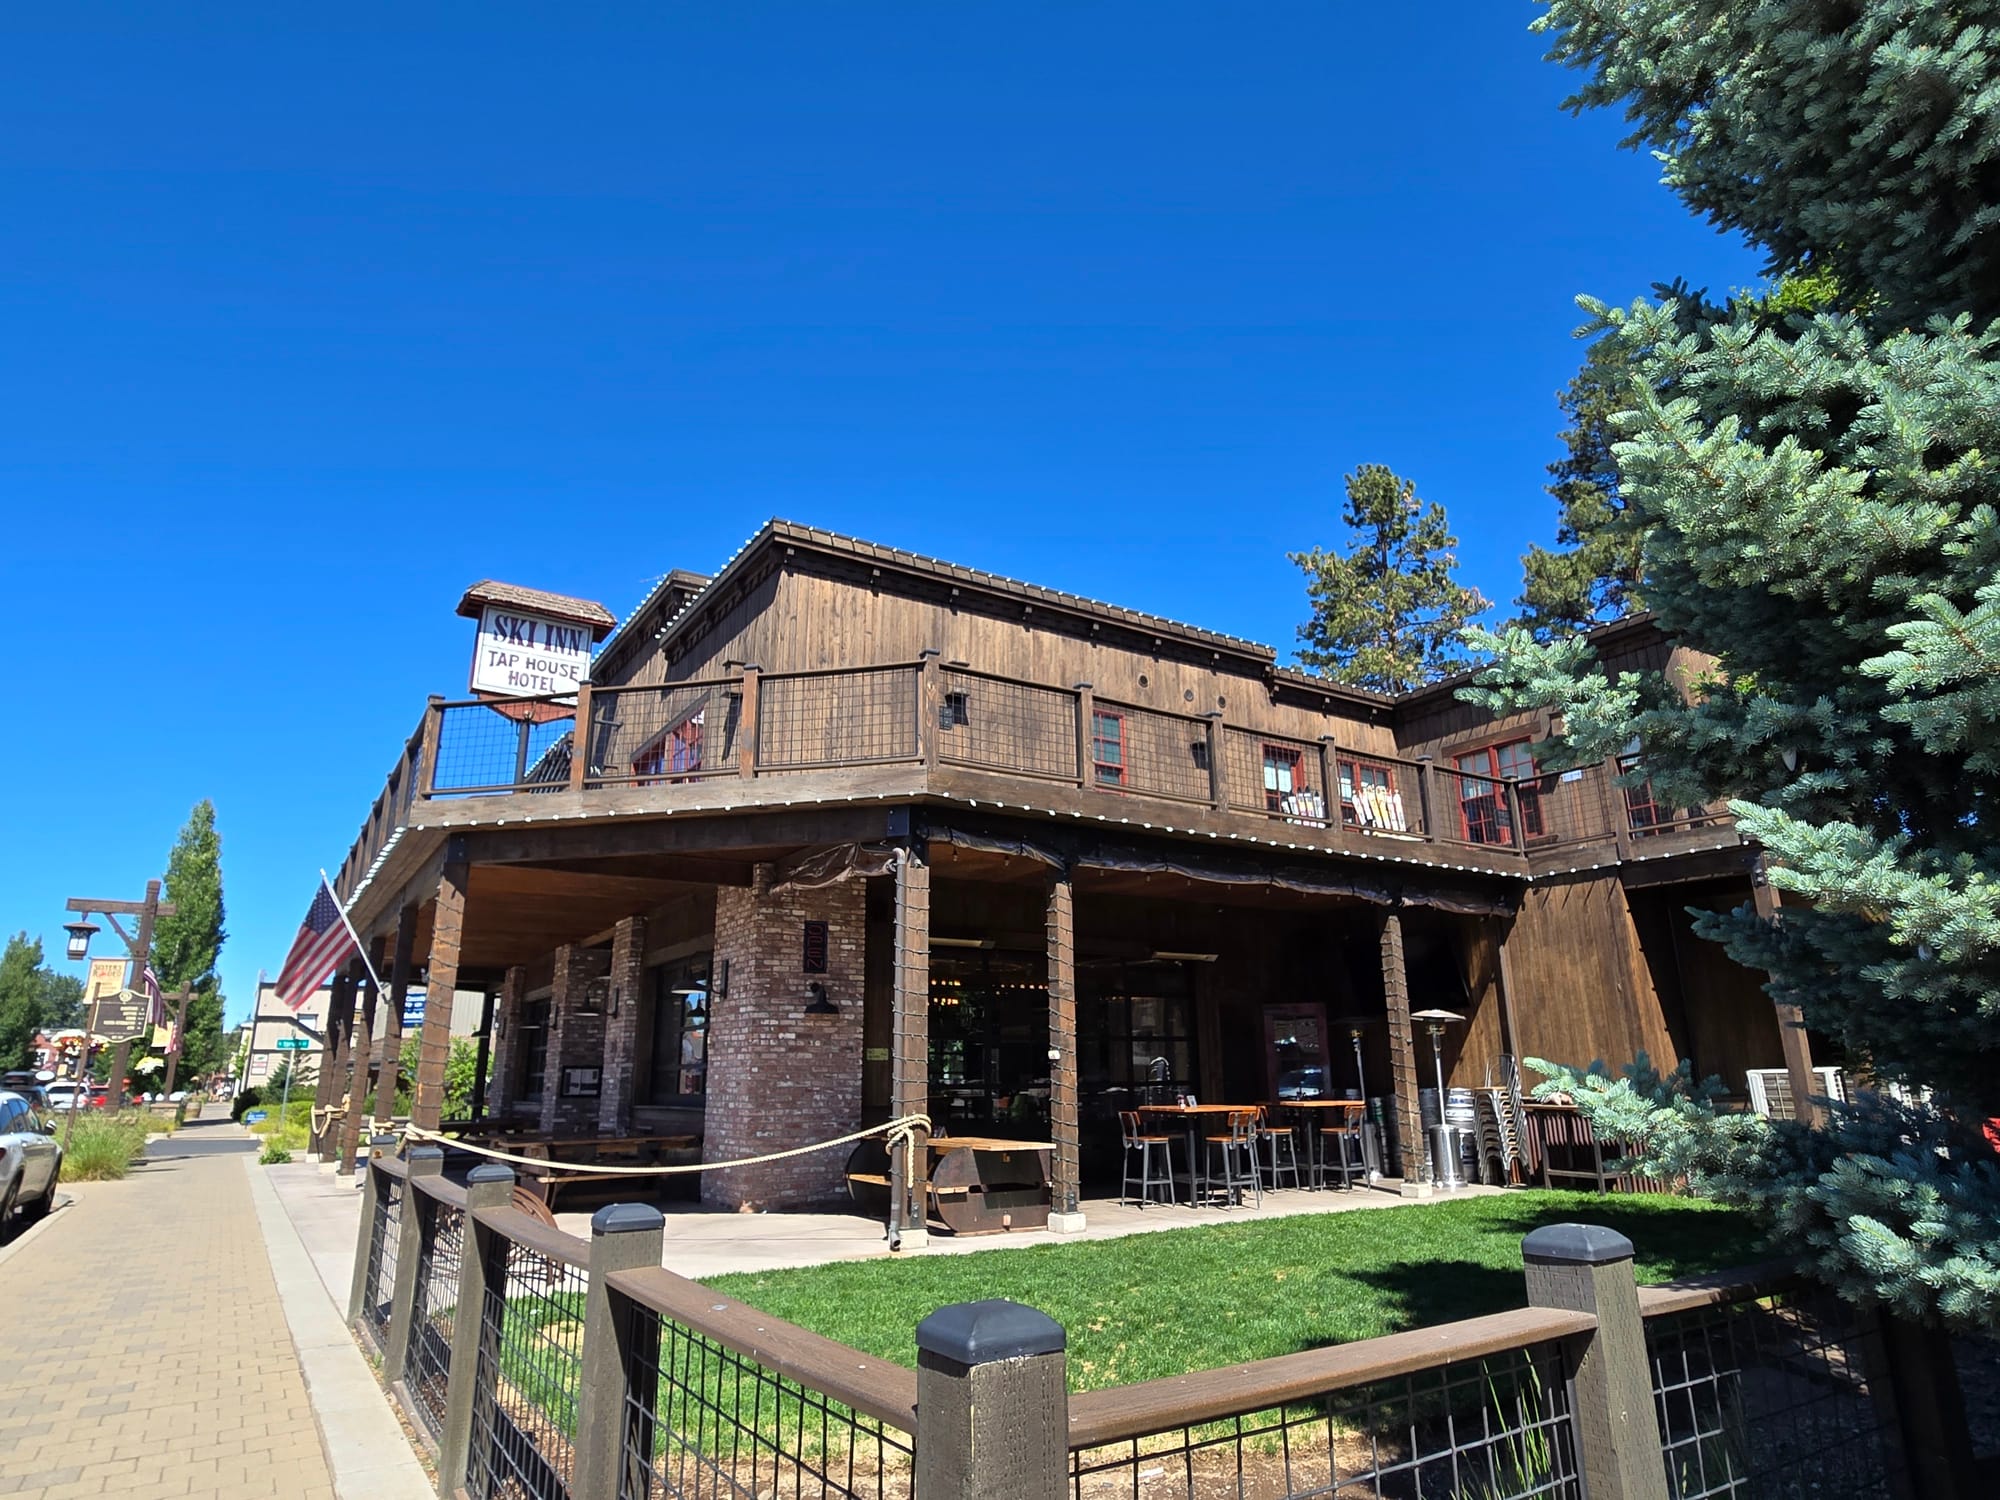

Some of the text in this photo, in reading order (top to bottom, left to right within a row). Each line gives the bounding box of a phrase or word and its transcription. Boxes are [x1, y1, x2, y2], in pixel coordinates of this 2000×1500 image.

[493, 614, 583, 657] SKI INN
[488, 650, 580, 683] TAP HOUSE
[508, 670, 556, 693] HOTEL
[807, 925, 824, 969] OPEN
